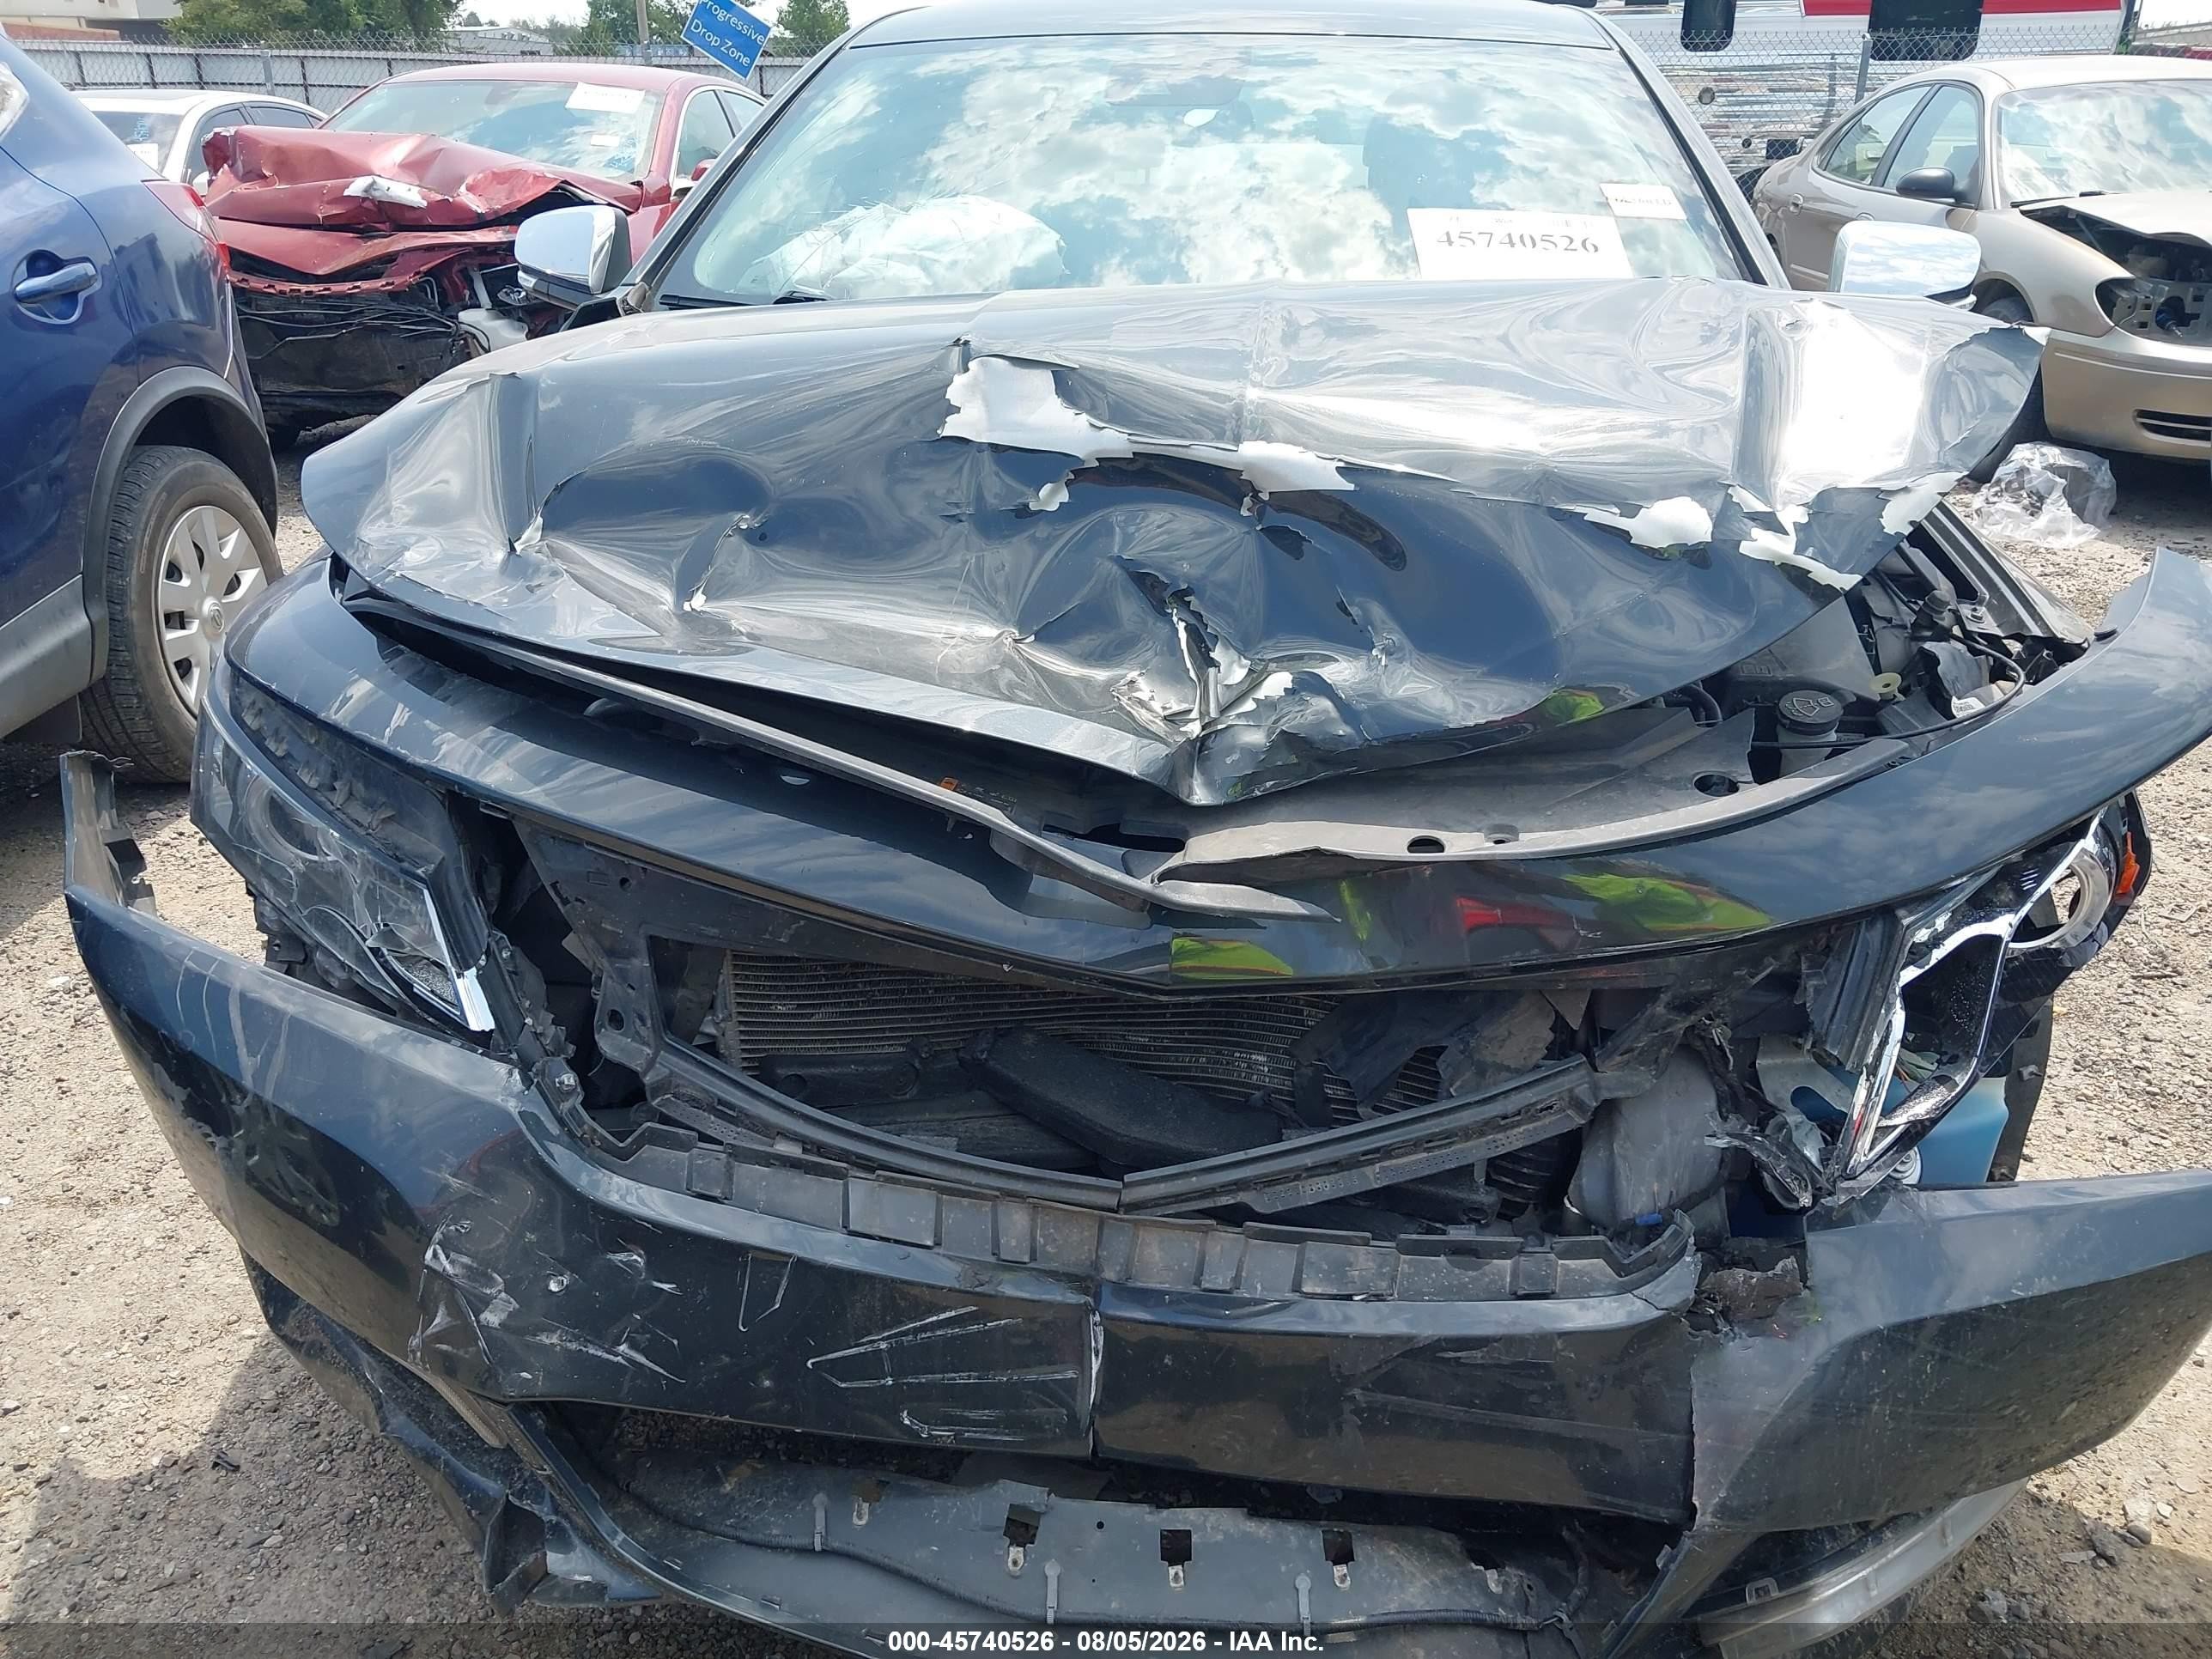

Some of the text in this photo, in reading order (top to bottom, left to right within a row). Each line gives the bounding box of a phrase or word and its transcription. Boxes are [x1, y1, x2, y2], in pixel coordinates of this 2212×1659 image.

[690, 19, 750, 67] Drop Zone
[1436, 230, 1599, 253] 45740526
